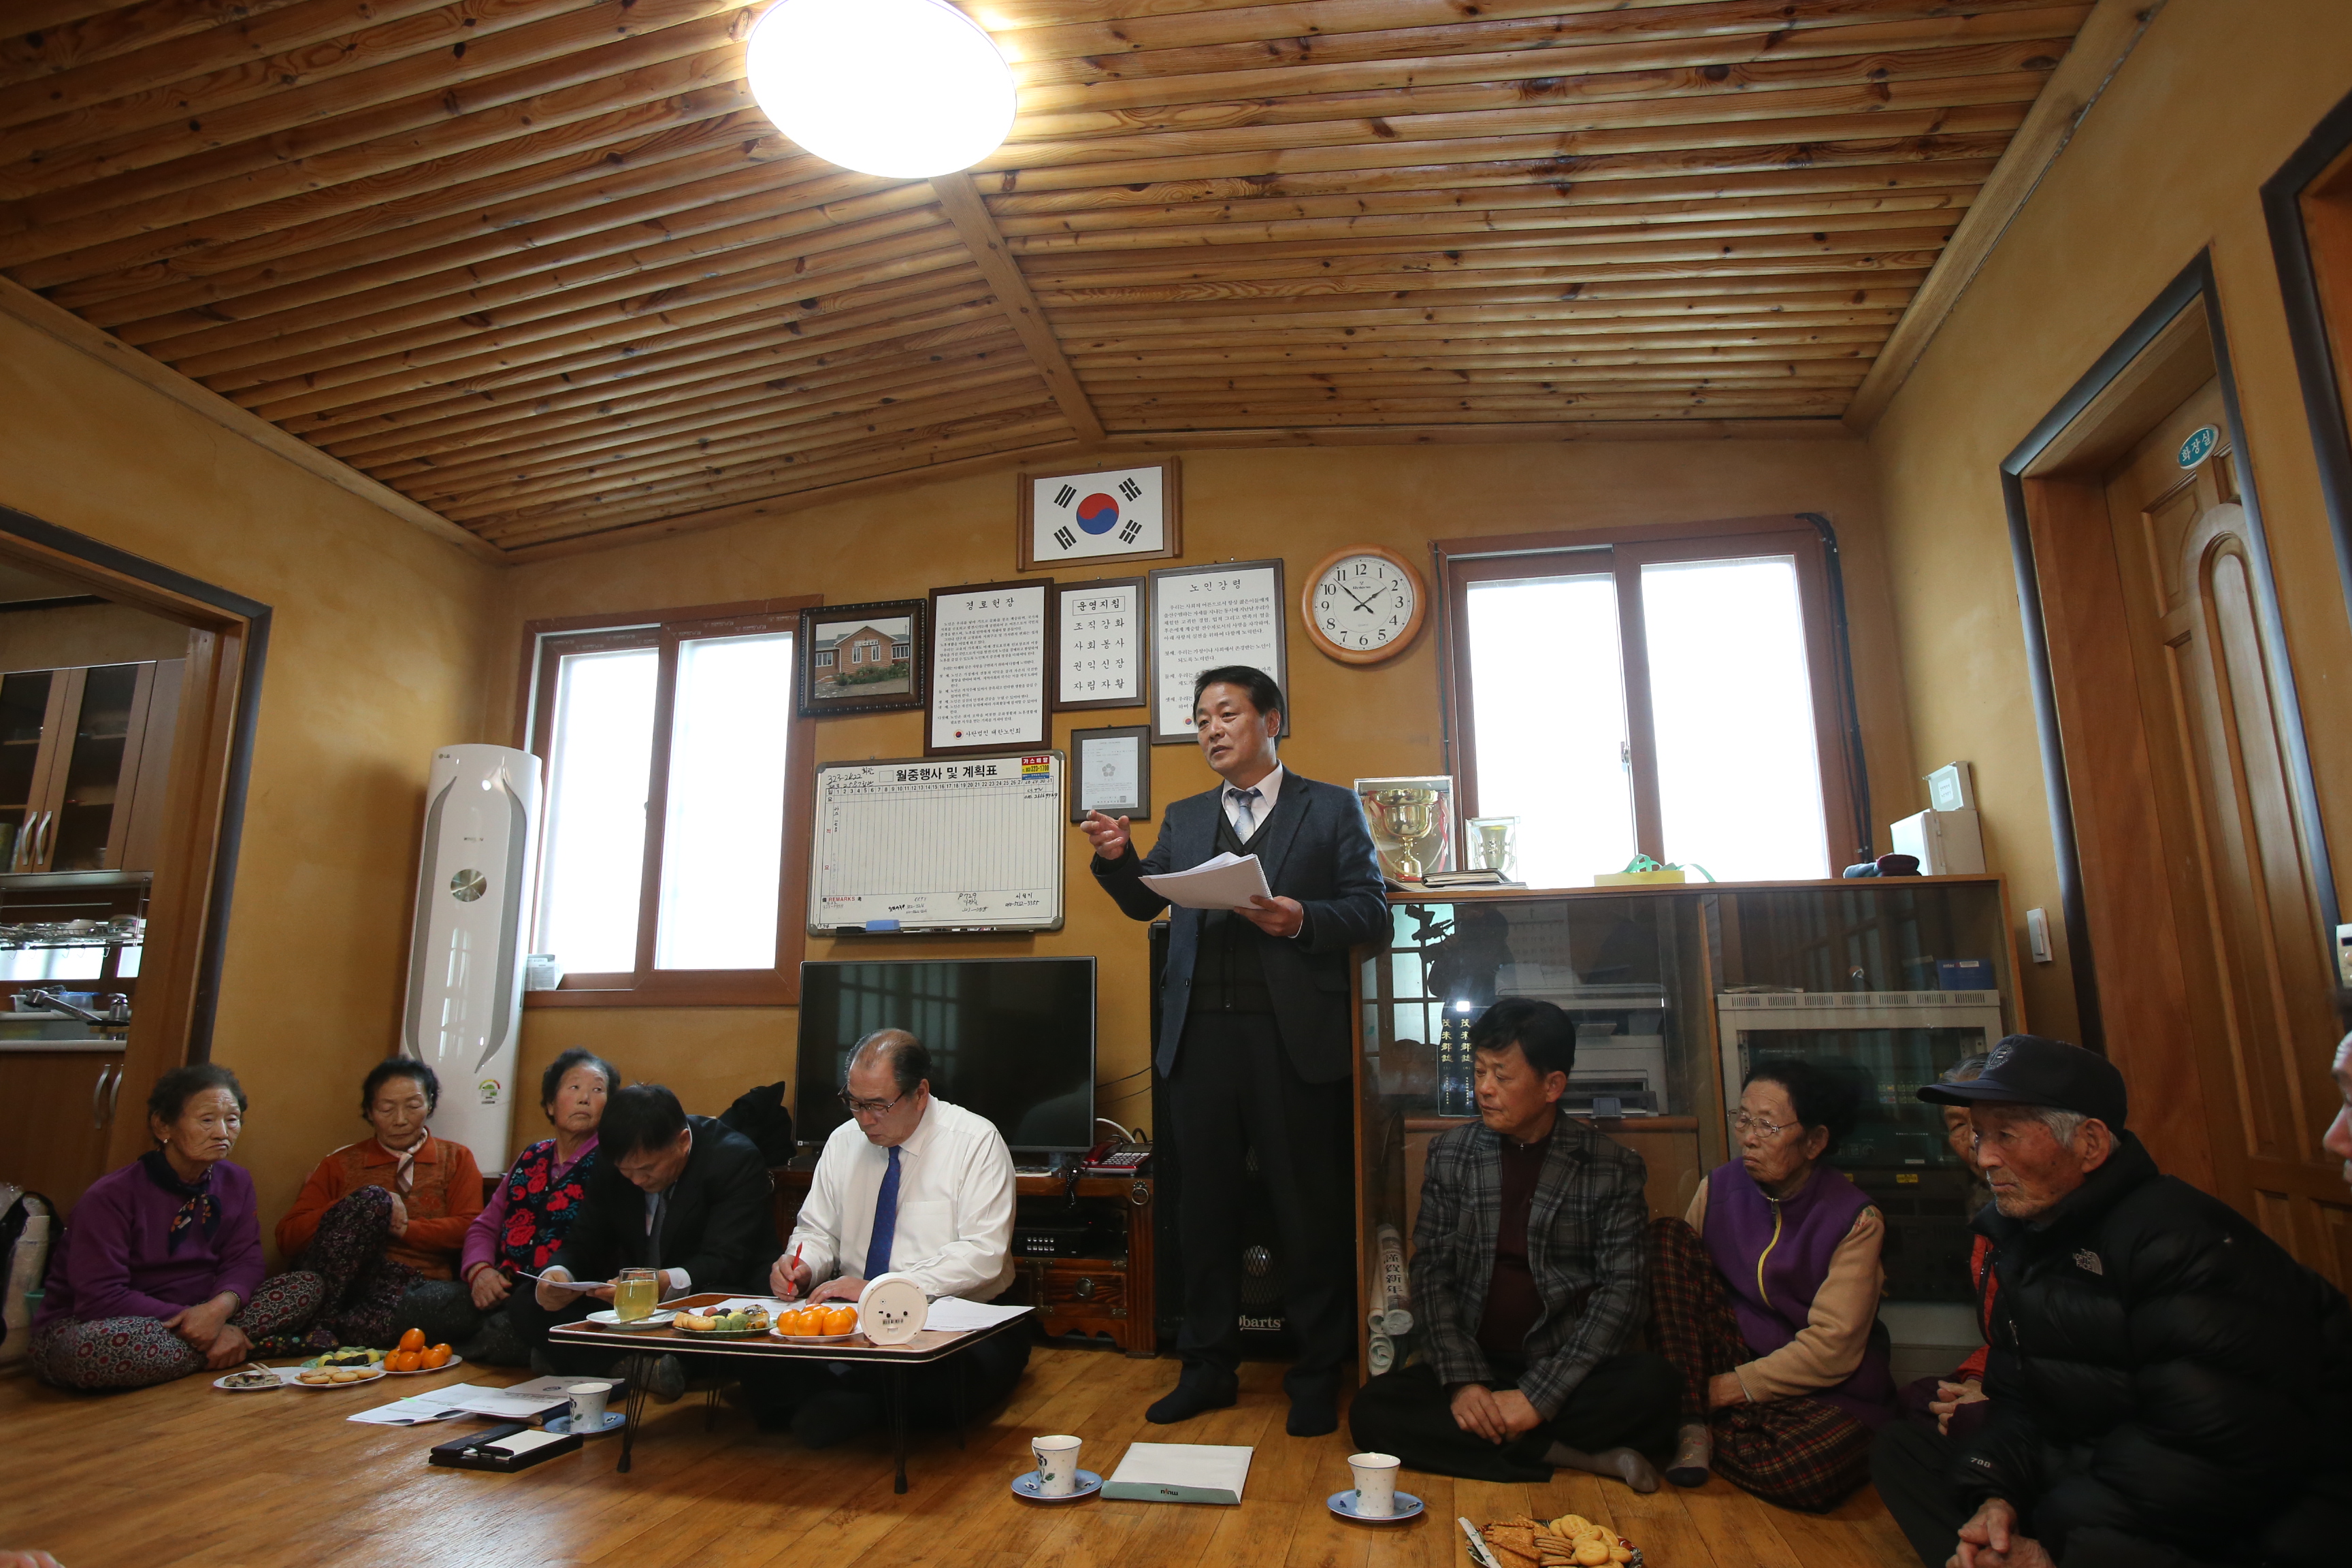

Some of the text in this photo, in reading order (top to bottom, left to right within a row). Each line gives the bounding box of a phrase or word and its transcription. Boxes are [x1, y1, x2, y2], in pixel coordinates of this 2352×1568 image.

[2181, 429, 2212, 462] 화장실
[1356, 564, 1367, 575] 12
[1379, 568, 1382, 578] 1
[1337, 570, 1345, 581] 11
[1189, 578, 1240, 592] 노인강령
[1324, 584, 1336, 595] 10
[1392, 580, 1399, 591] 2
[965, 597, 1014, 610] 경로헌장
[1077, 599, 1119, 610] 운영지침
[1322, 602, 1329, 612] 9
[1395, 597, 1403, 608] 3
[1074, 618, 1124, 631] 조직강화
[1327, 618, 1335, 630] 8
[1389, 615, 1397, 625] 4
[1341, 631, 1348, 642] 7
[1360, 634, 1368, 645] 6
[1378, 630, 1386, 640] 5
[1074, 638, 1124, 651] 사회봉사
[1073, 658, 1124, 671] 권익신장
[1074, 679, 1124, 691] 자립자활
[965, 727, 1020, 737] 사단법인 대한노인회
[896, 765, 997, 781] 월중행사 및 계획표
[1971, 1458, 1991, 1468] 700
